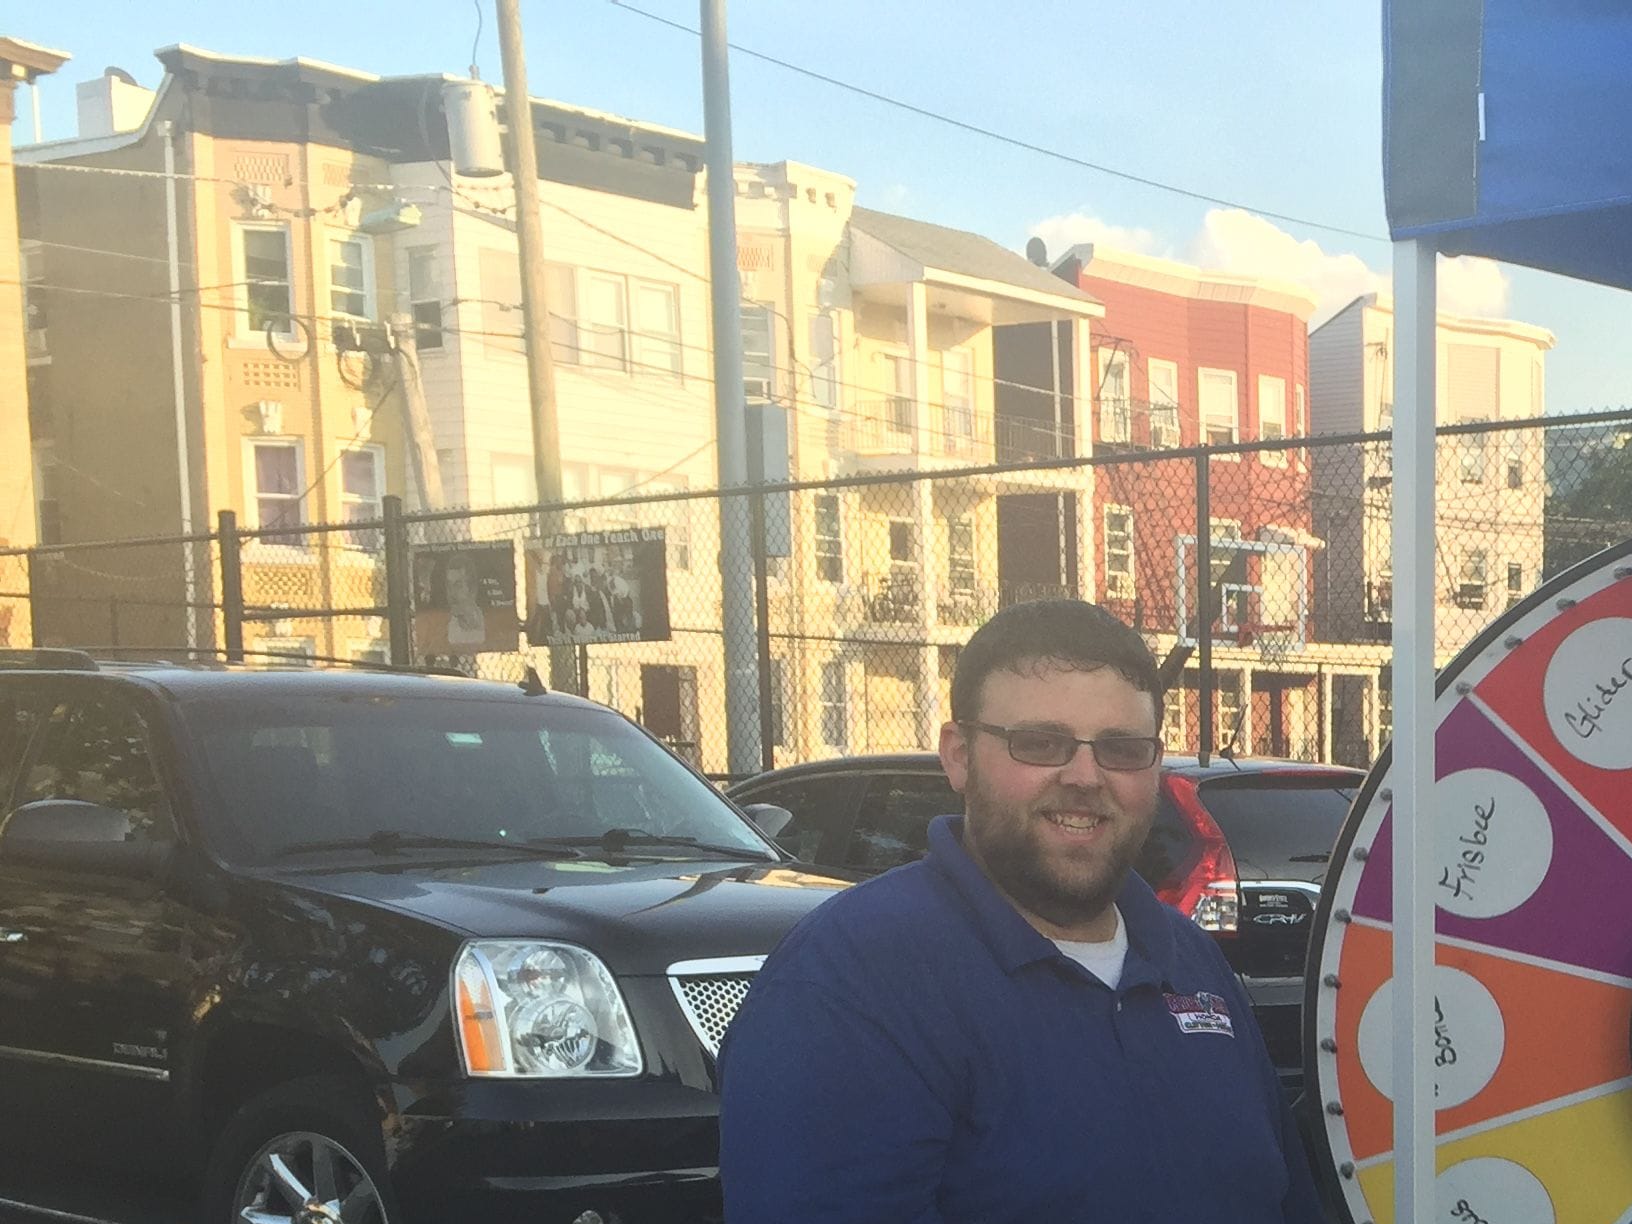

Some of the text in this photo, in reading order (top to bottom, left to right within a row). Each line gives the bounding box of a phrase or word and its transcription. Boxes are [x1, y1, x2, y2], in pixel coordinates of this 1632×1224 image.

[580, 533, 600, 545] One
[603, 530, 639, 544] Teach
[641, 527, 664, 541] One
[1438, 796, 1495, 901] Frisbee
